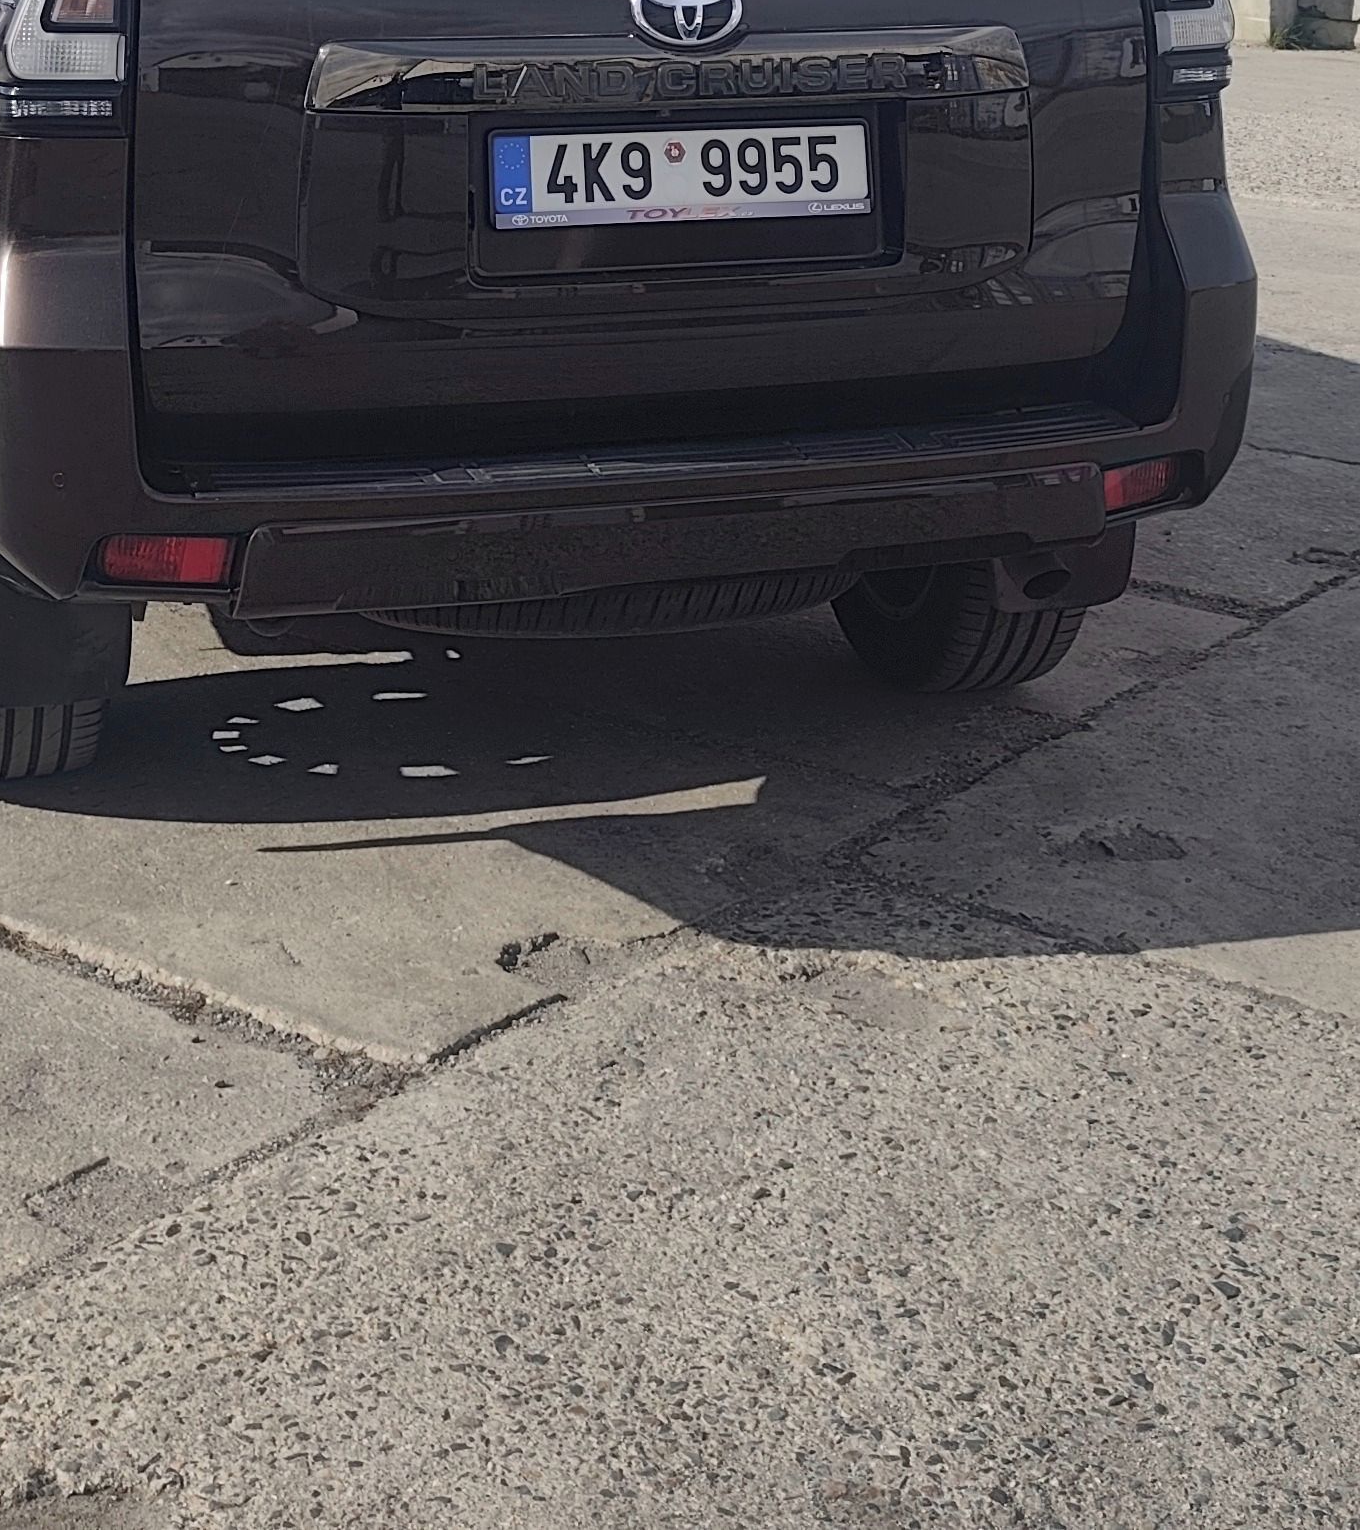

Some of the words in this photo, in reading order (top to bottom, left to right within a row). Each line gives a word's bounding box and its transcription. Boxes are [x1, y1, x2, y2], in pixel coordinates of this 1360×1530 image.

[472, 62, 639, 101] LAND
[655, 53, 909, 98] CRUISER
[500, 187, 528, 206] CZ
[546, 141, 653, 204] 4K9
[700, 135, 839, 197] 9955
[529, 214, 569, 224] TOYOTA
[823, 202, 865, 211] LEXUS
